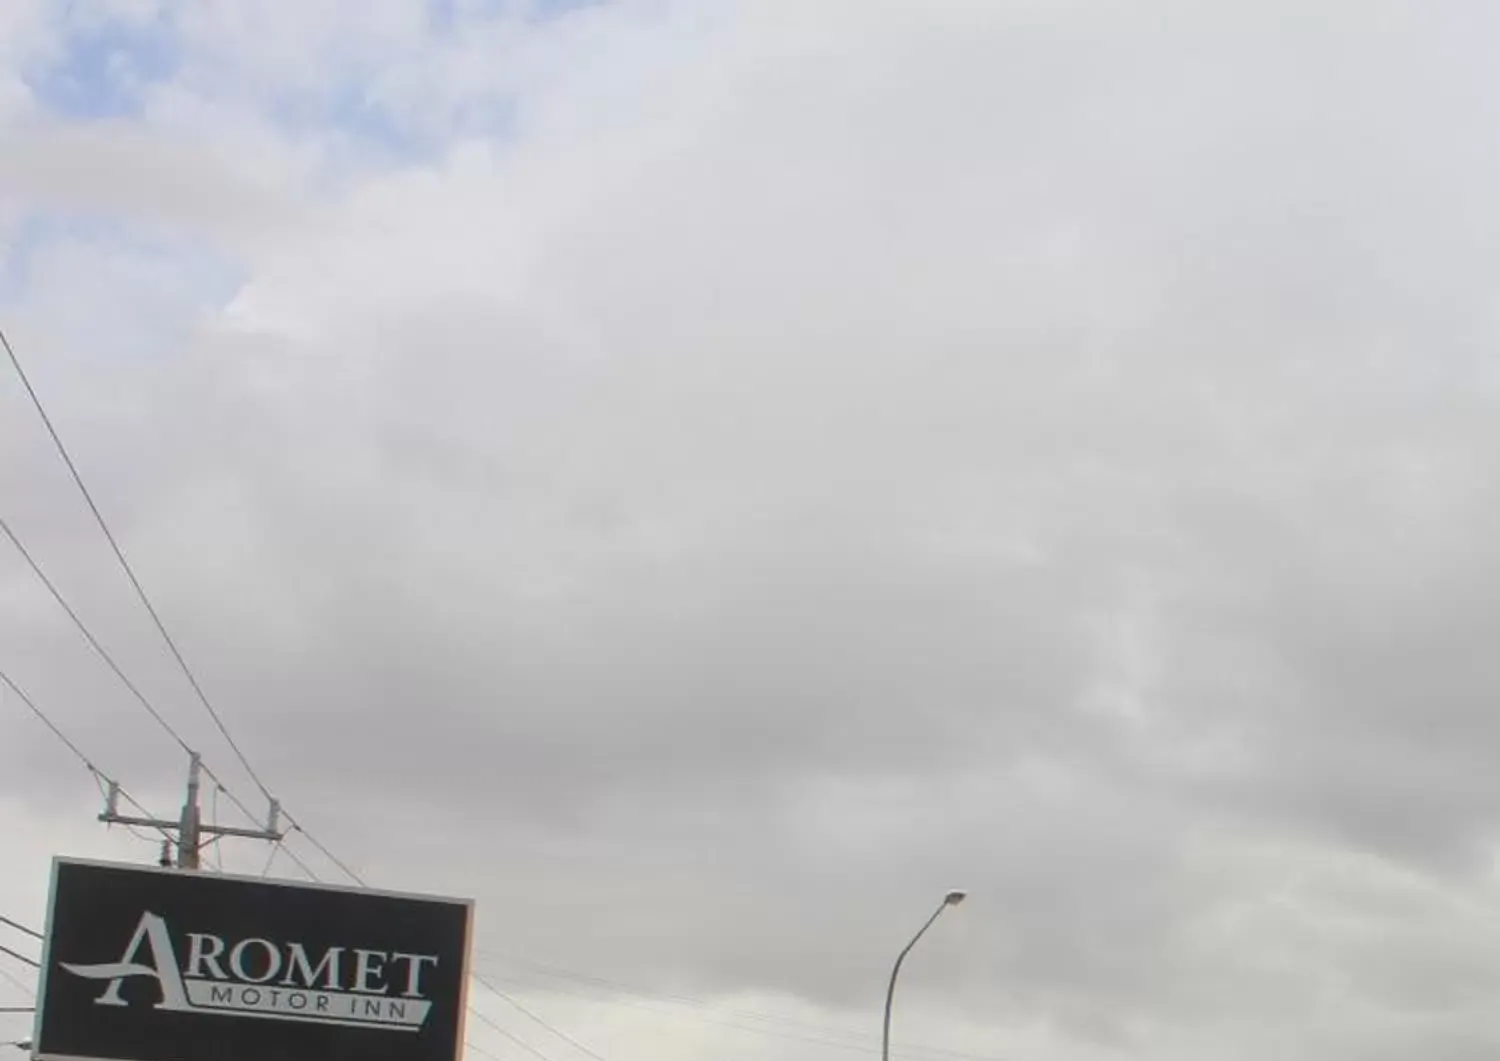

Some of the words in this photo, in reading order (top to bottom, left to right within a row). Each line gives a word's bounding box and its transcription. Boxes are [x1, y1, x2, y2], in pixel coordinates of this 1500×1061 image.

[59, 910, 438, 1010] AROMET
[210, 985, 329, 1012] MOTOR
[350, 995, 406, 1019] INN
